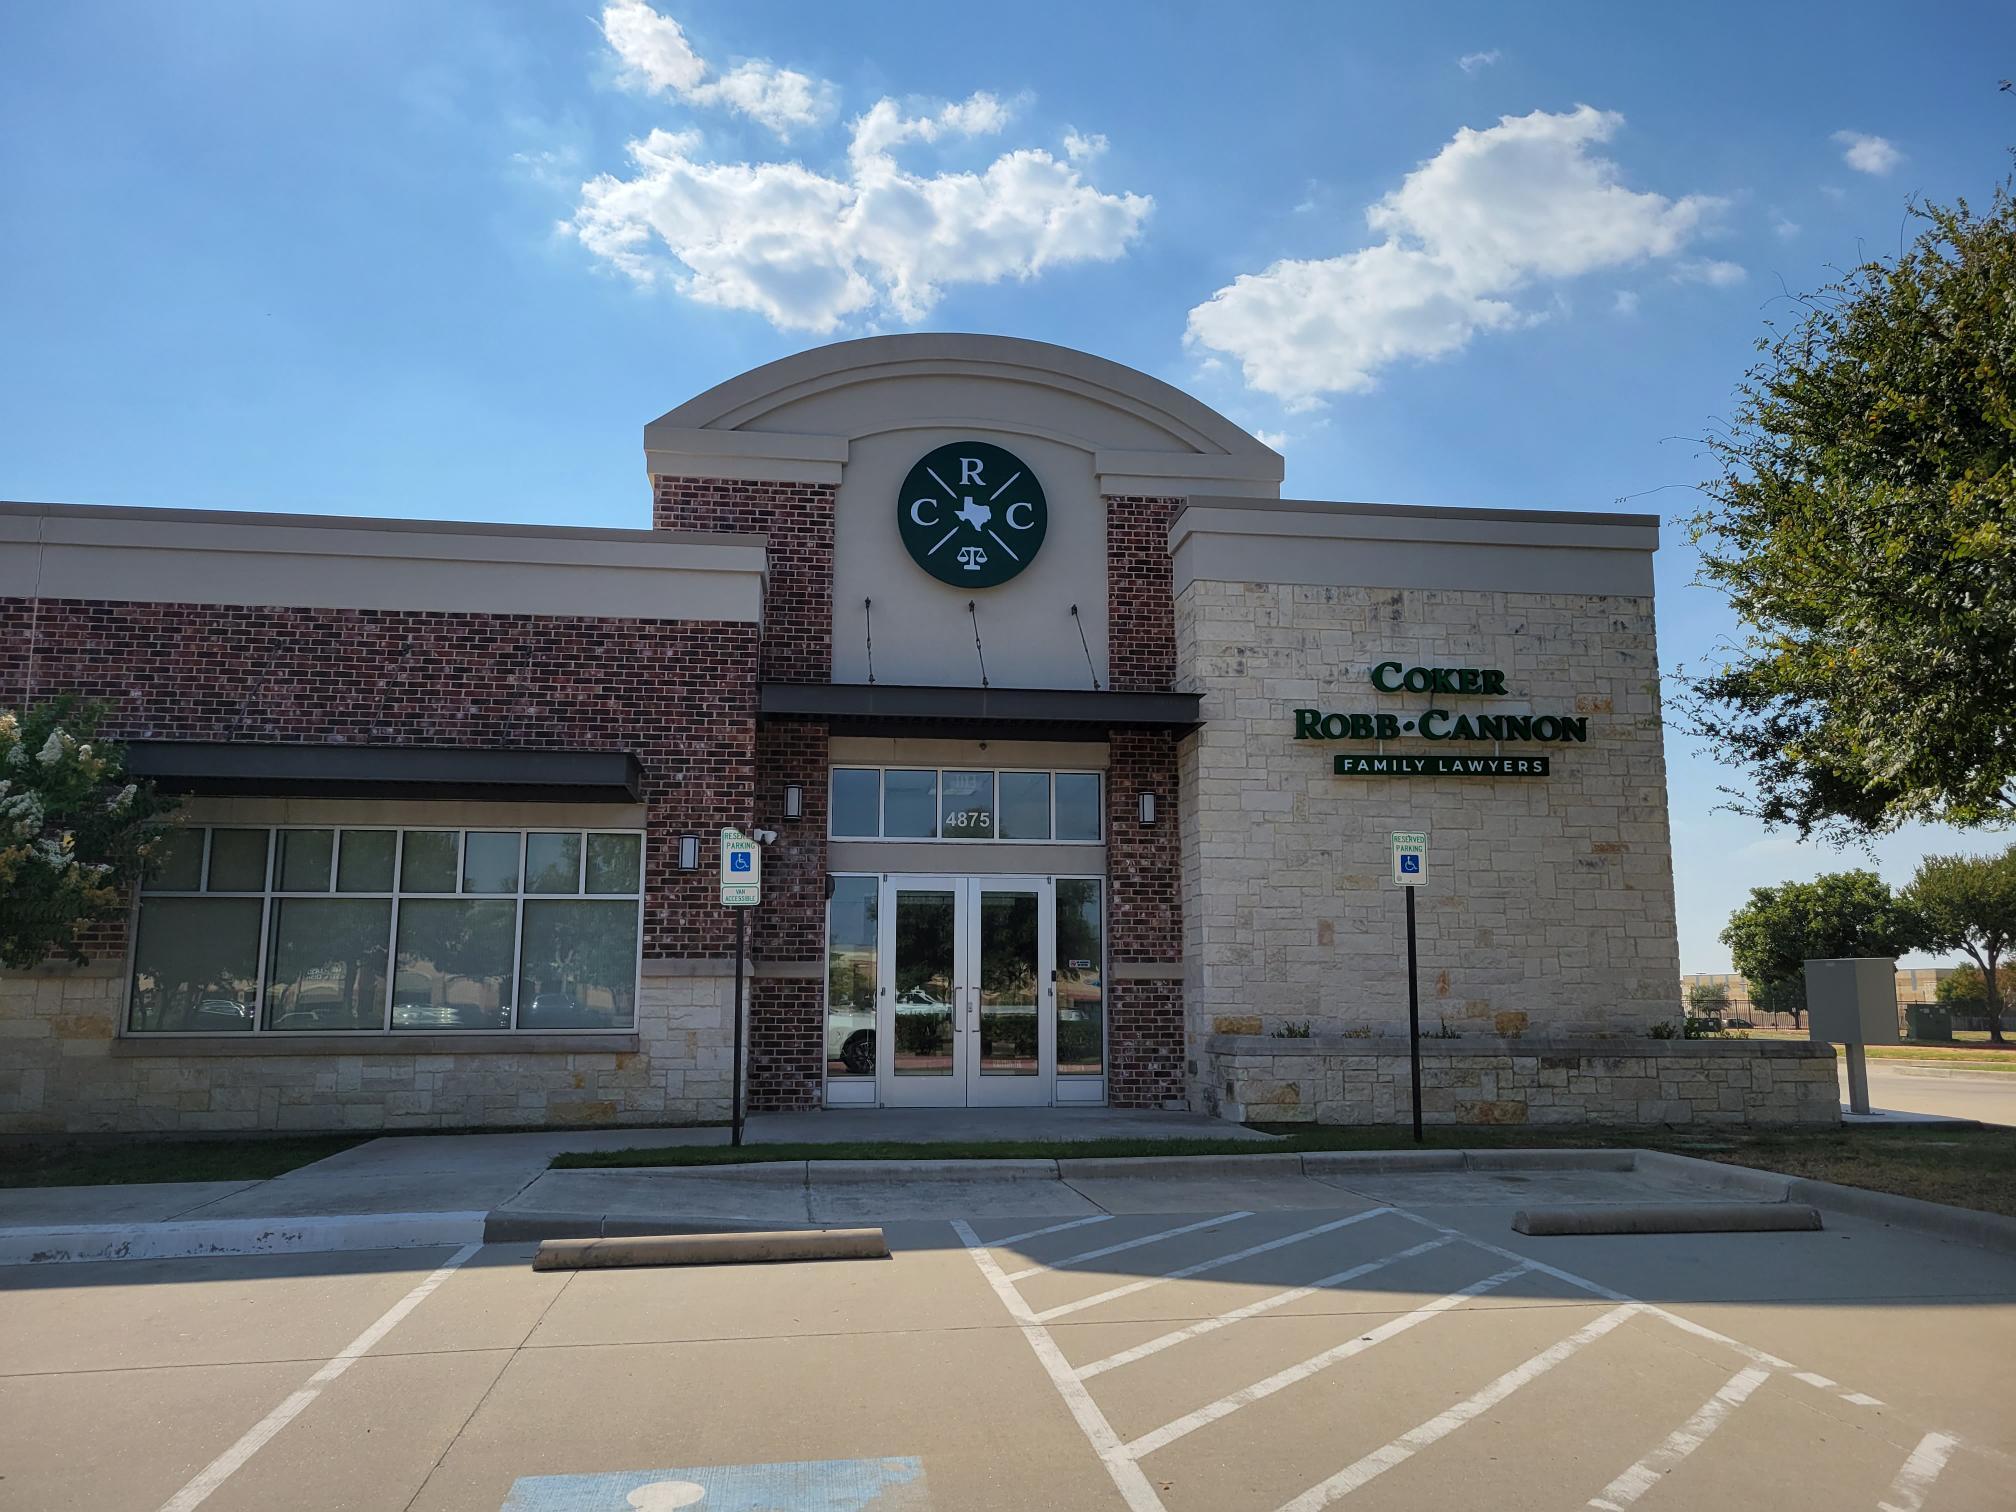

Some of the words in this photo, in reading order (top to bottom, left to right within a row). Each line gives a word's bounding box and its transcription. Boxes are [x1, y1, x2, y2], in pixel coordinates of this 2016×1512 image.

[959, 457, 987, 486] R
[910, 498, 940, 526] C
[1005, 502, 1035, 530] C
[1371, 661, 1509, 695] COKER
[1344, 759, 1425, 772] FAMILY
[1439, 760, 1543, 773] LAWYERS
[945, 811, 990, 827] 4875
